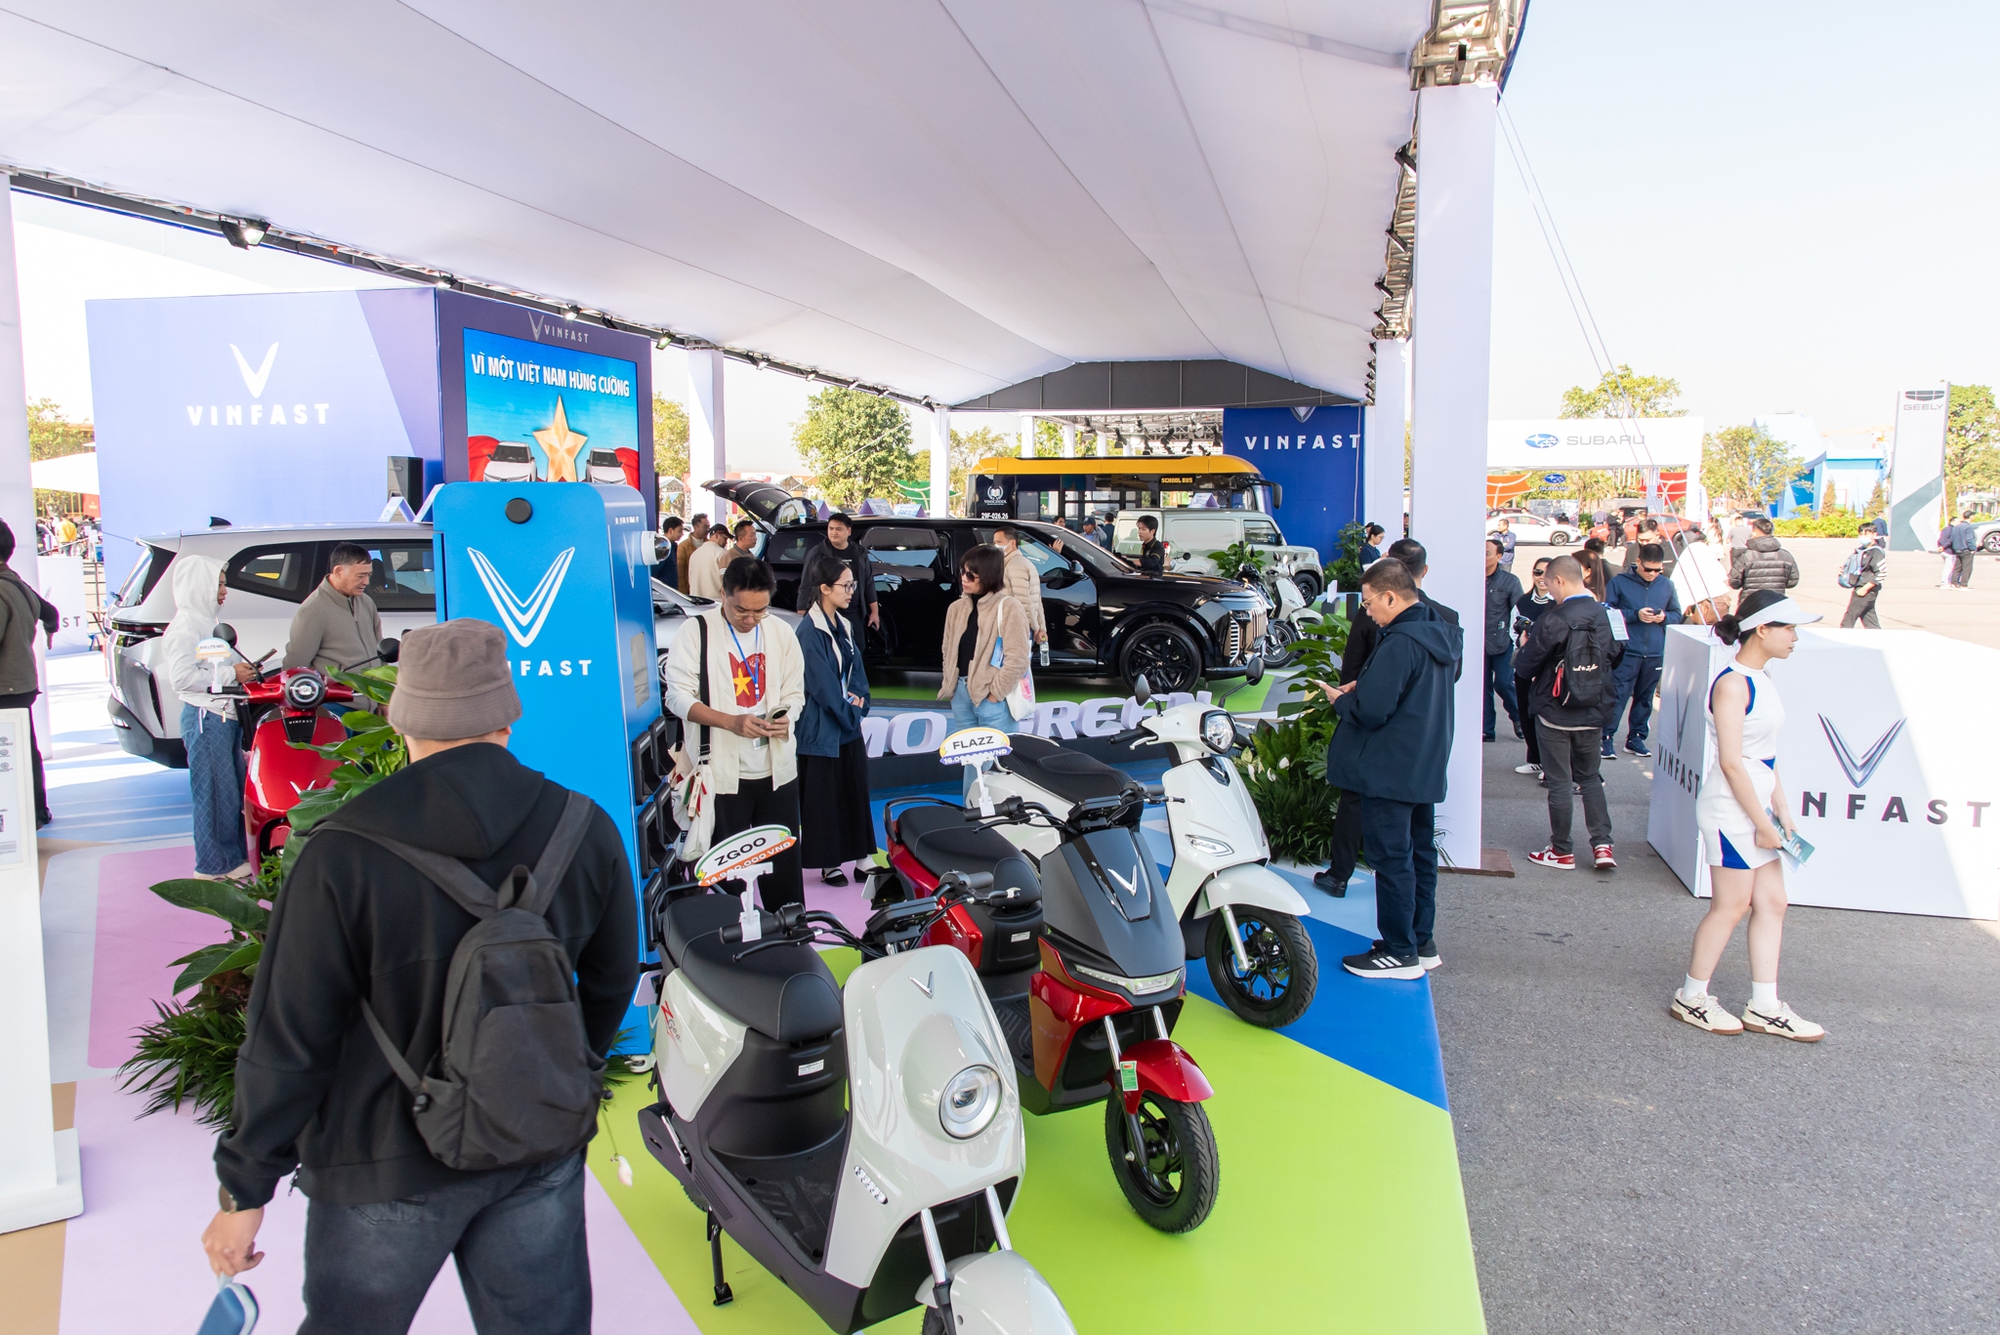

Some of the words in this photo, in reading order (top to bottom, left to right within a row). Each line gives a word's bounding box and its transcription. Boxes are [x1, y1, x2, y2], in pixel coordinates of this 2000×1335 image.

[544, 324, 589, 344] VINFAST
[471, 351, 485, 375] VÌ
[488, 354, 514, 382] MỘT
[517, 359, 540, 386] VIỆT
[543, 365, 567, 388] NAM
[569, 368, 597, 393] HÙNG
[598, 374, 631, 398] CƯỜNG
[187, 402, 330, 427] VINFAST
[1903, 403, 1944, 411] GEELY
[1244, 434, 1361, 451] VINFAST
[1566, 435, 1645, 446] SUBARU
[508, 660, 592, 677] FAST
[952, 735, 994, 750] FLAZZ
[1657, 743, 1700, 800] VINFAST
[1801, 791, 1991, 828] NFAST
[714, 837, 767, 867] ZGOO
[767, 841, 791, 855] VND
